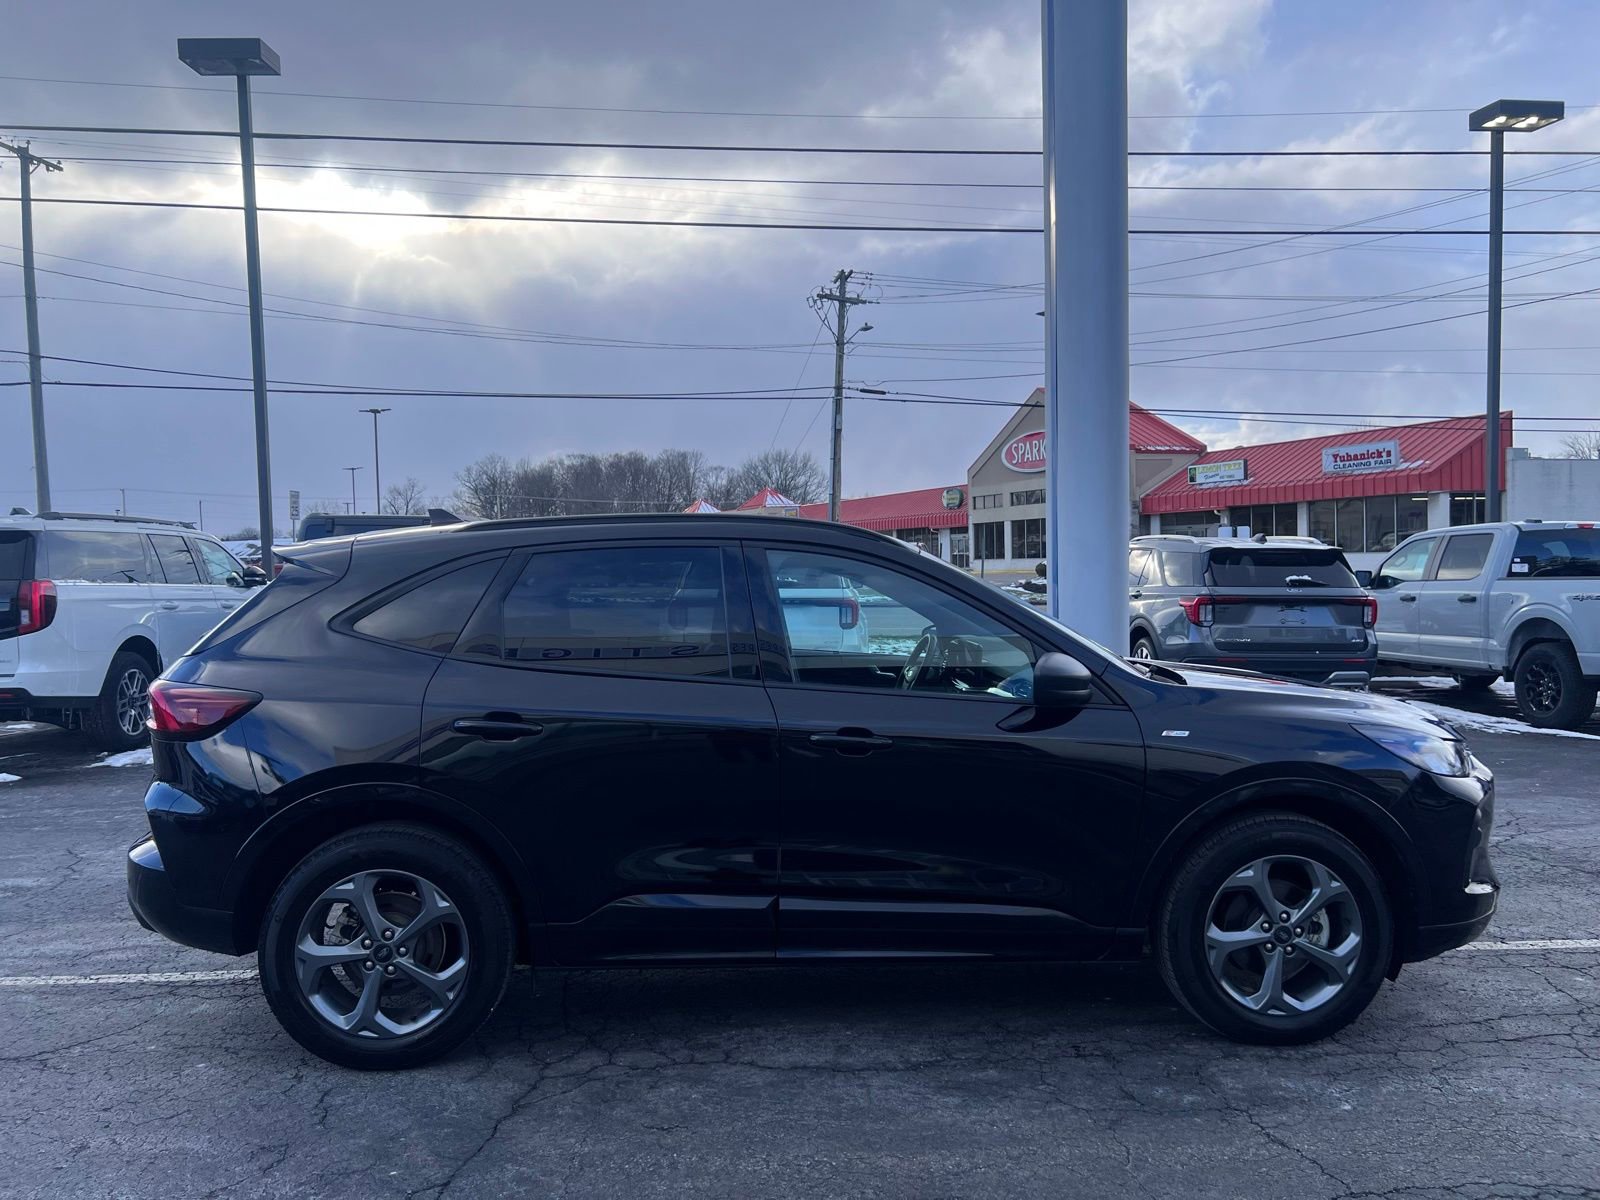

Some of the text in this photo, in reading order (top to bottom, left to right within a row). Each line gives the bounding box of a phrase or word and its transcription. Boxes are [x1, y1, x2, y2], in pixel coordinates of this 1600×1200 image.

[1011, 438, 1046, 464] SPARK
[1332, 448, 1392, 463] Yuhanick's
[1333, 458, 1392, 470] CLEANING FAIR
